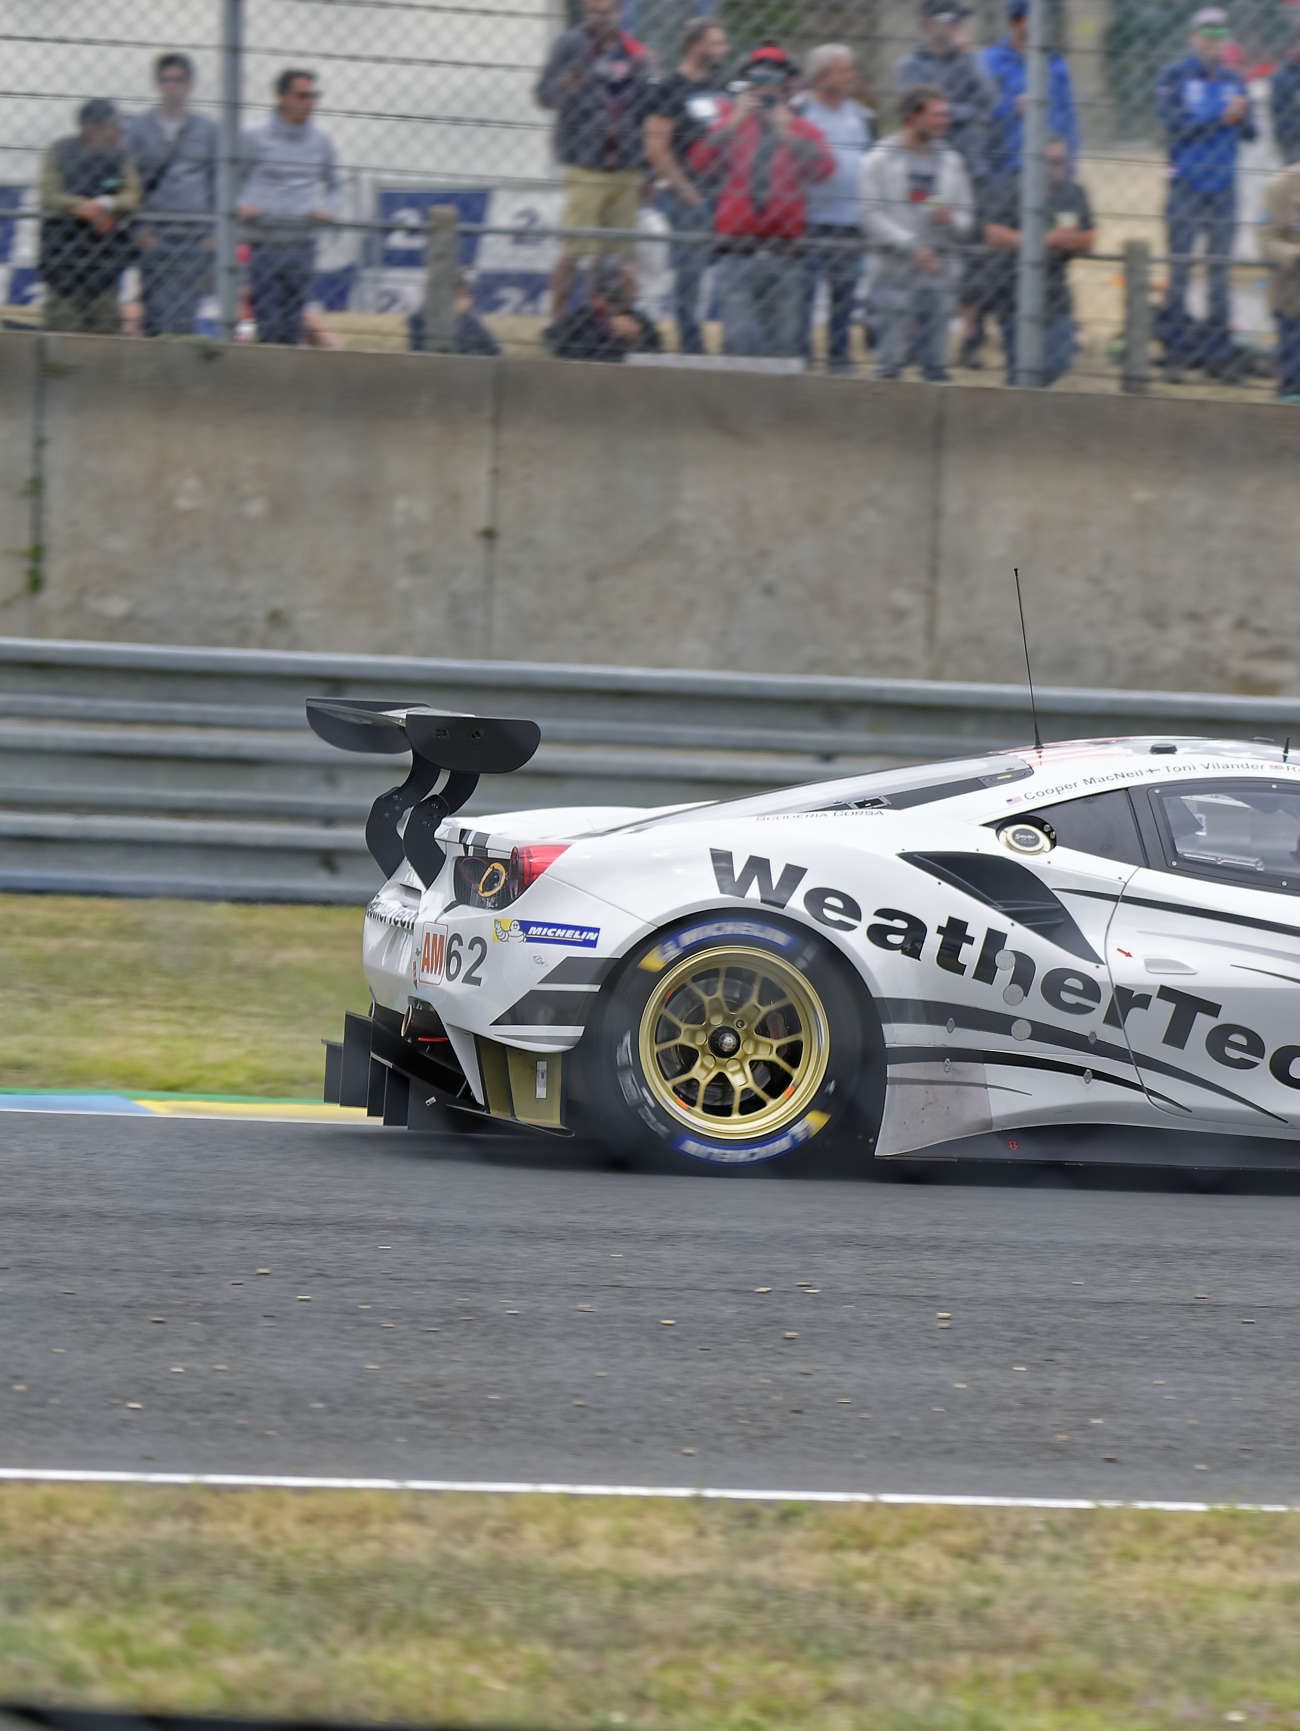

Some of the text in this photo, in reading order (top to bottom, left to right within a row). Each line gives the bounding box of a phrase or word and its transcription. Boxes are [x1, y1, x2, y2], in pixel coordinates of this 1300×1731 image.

[1165, 762, 1265, 774] Toni Vilander
[1023, 769, 1144, 801] Cooper MacNeil
[527, 926, 599, 941] MICHELIN
[421, 932, 445, 975] AM
[446, 933, 488, 986] 62
